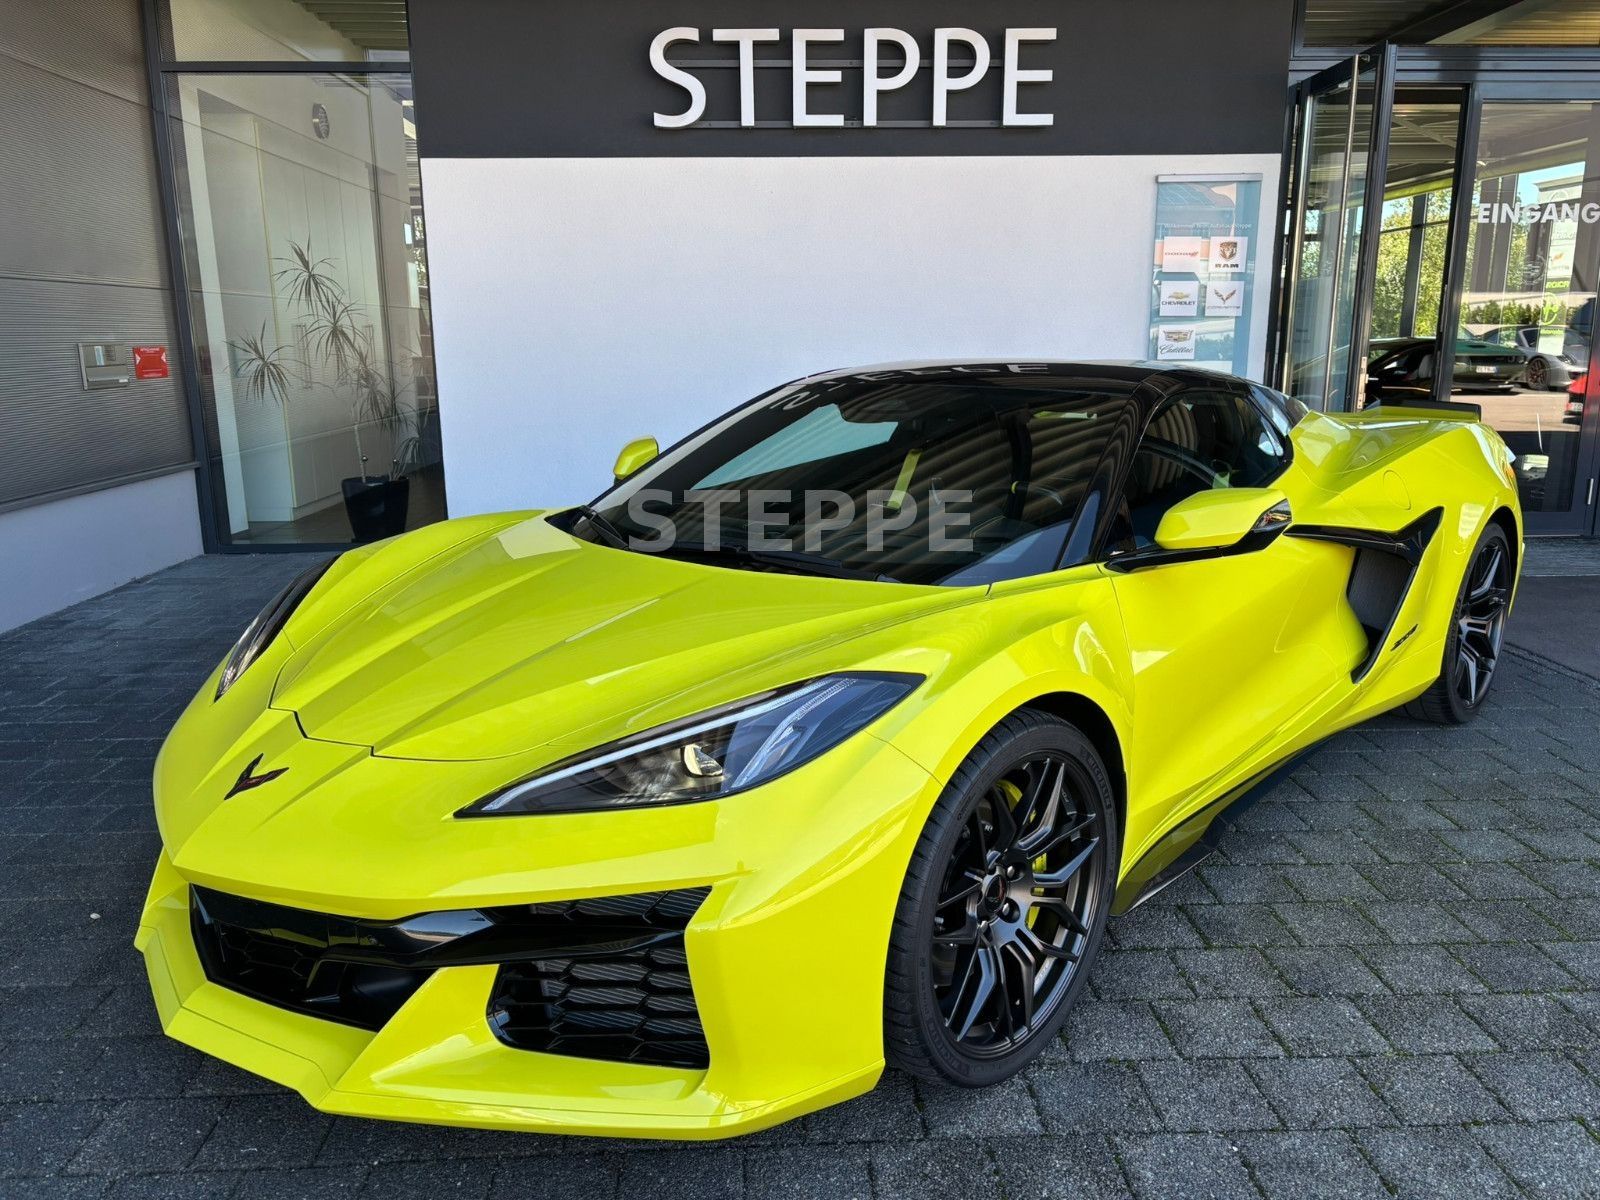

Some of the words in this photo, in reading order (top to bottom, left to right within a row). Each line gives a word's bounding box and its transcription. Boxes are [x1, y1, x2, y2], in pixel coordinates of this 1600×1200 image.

[649, 26, 1057, 128] STEPPE
[1477, 202, 1600, 224] EINGANG
[1159, 344, 1194, 355] Cadillac
